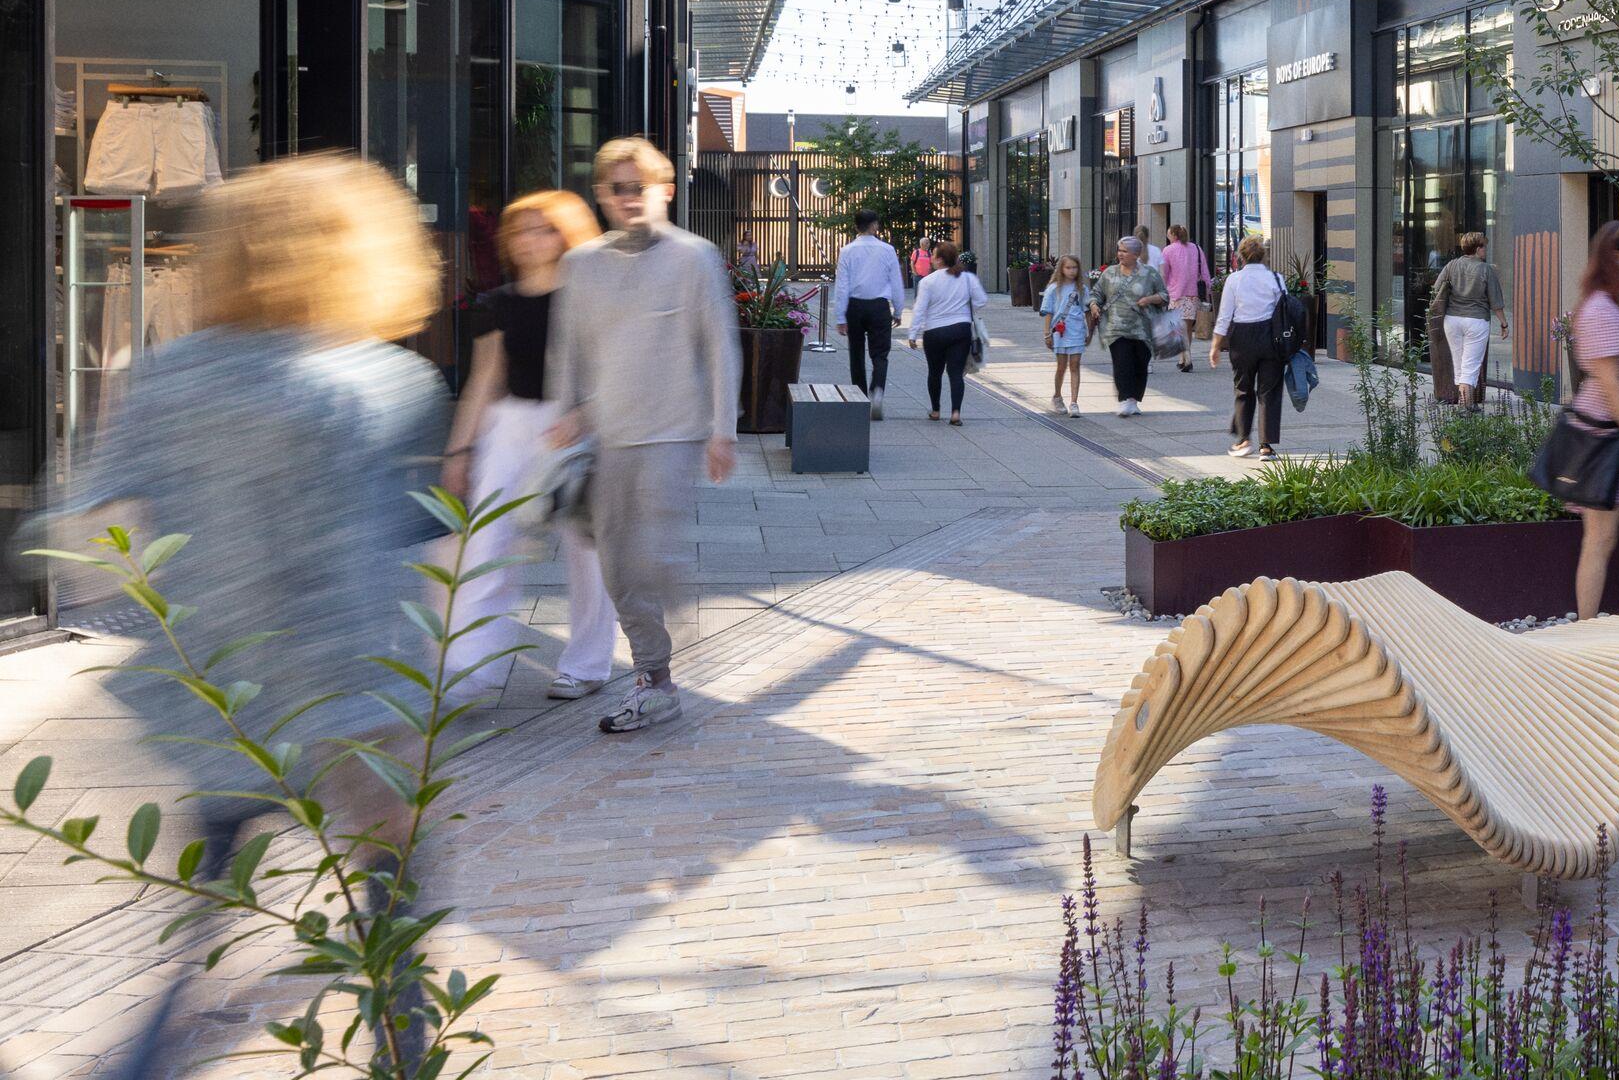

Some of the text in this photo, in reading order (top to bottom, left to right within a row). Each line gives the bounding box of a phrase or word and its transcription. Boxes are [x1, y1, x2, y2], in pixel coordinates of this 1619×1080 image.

[1275, 51, 1333, 84] BOYS OF EUROPE
[1047, 119, 1071, 153] ONLY
